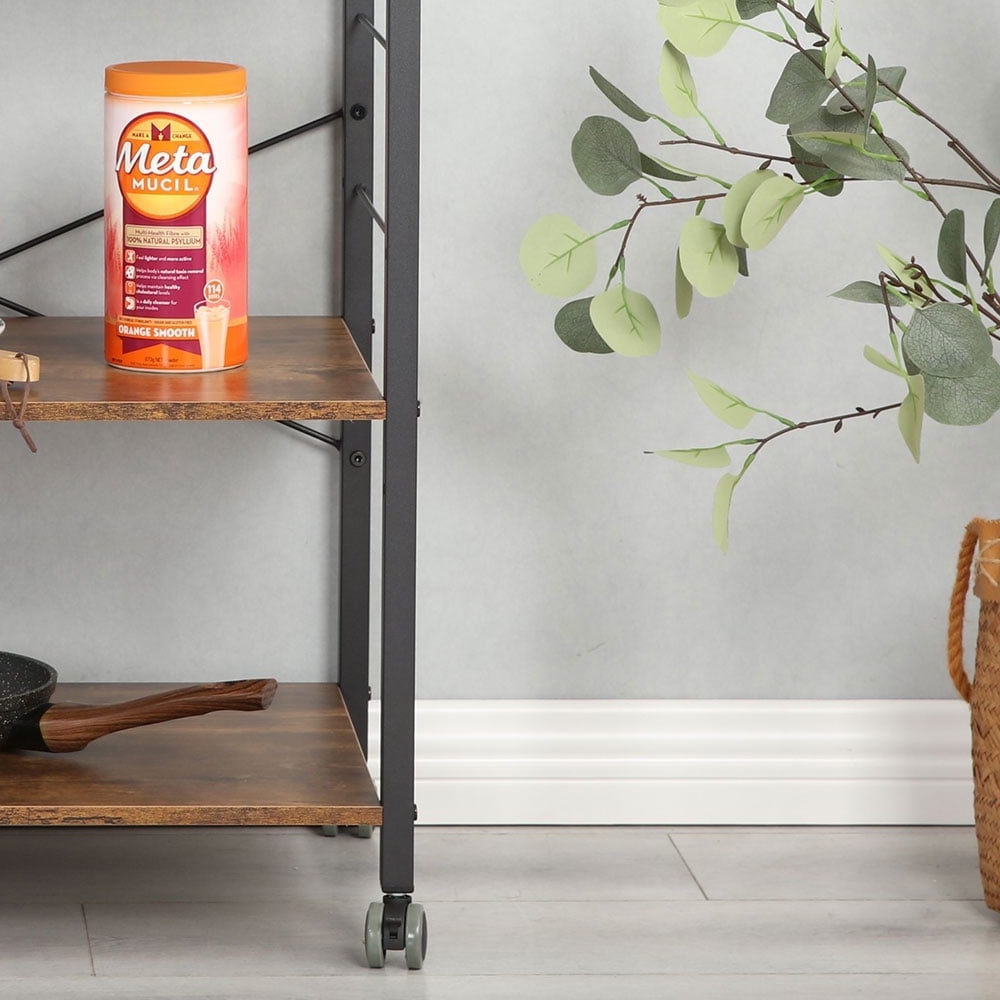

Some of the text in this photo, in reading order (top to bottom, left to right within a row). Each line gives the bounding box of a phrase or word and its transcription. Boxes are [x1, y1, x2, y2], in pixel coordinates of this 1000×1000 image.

[115, 141, 217, 175] Meta
[143, 236, 169, 244] NATURAL
[171, 237, 201, 245] PSYLLIUM
[118, 324, 195, 338] ORANGE SMOOTH
